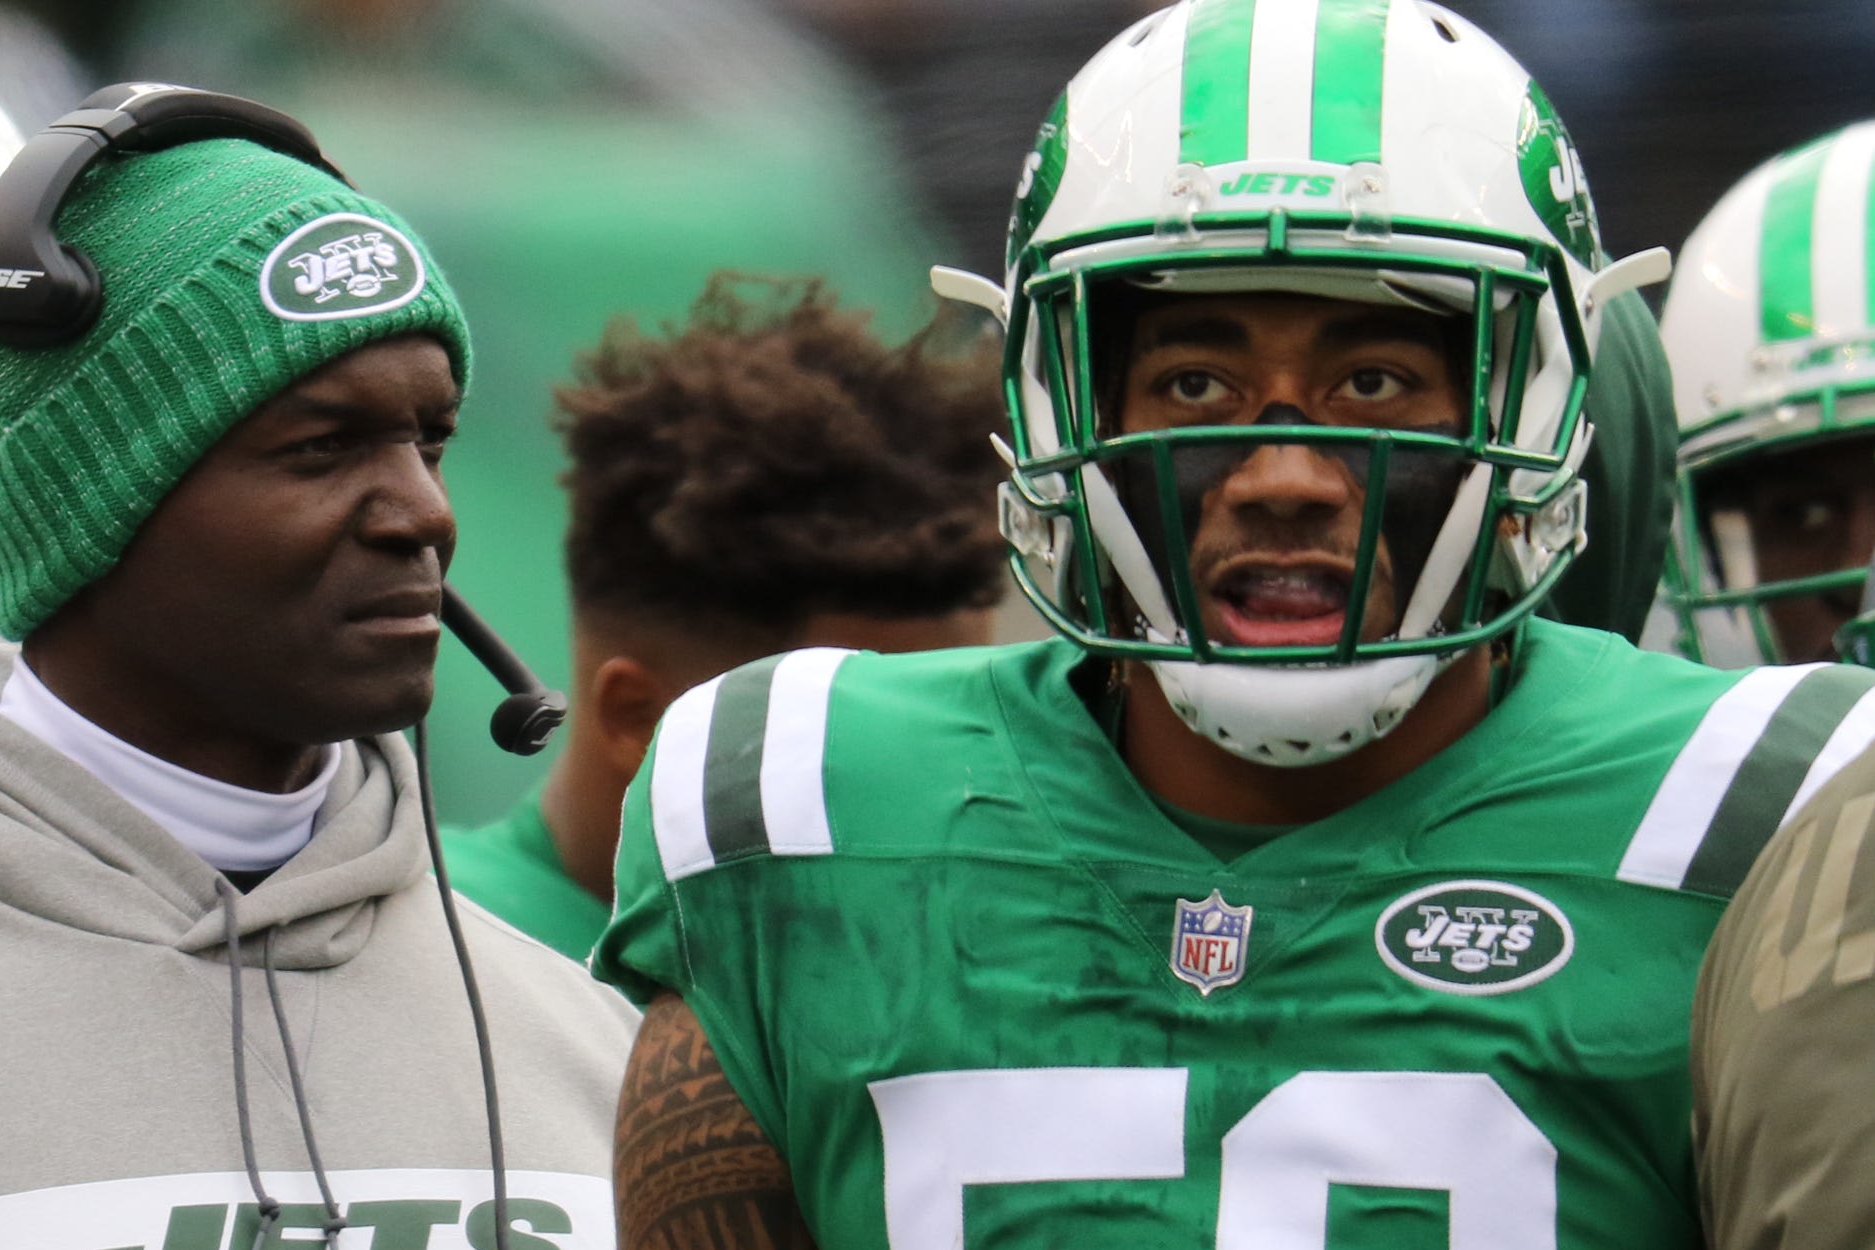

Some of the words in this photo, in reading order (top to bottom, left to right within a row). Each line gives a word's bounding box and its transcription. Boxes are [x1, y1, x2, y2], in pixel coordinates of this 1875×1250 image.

[1219, 172, 1336, 196] JETS
[295, 243, 398, 295] JETS
[1406, 914, 1535, 952] JETS
[1182, 936, 1235, 976] NFL
